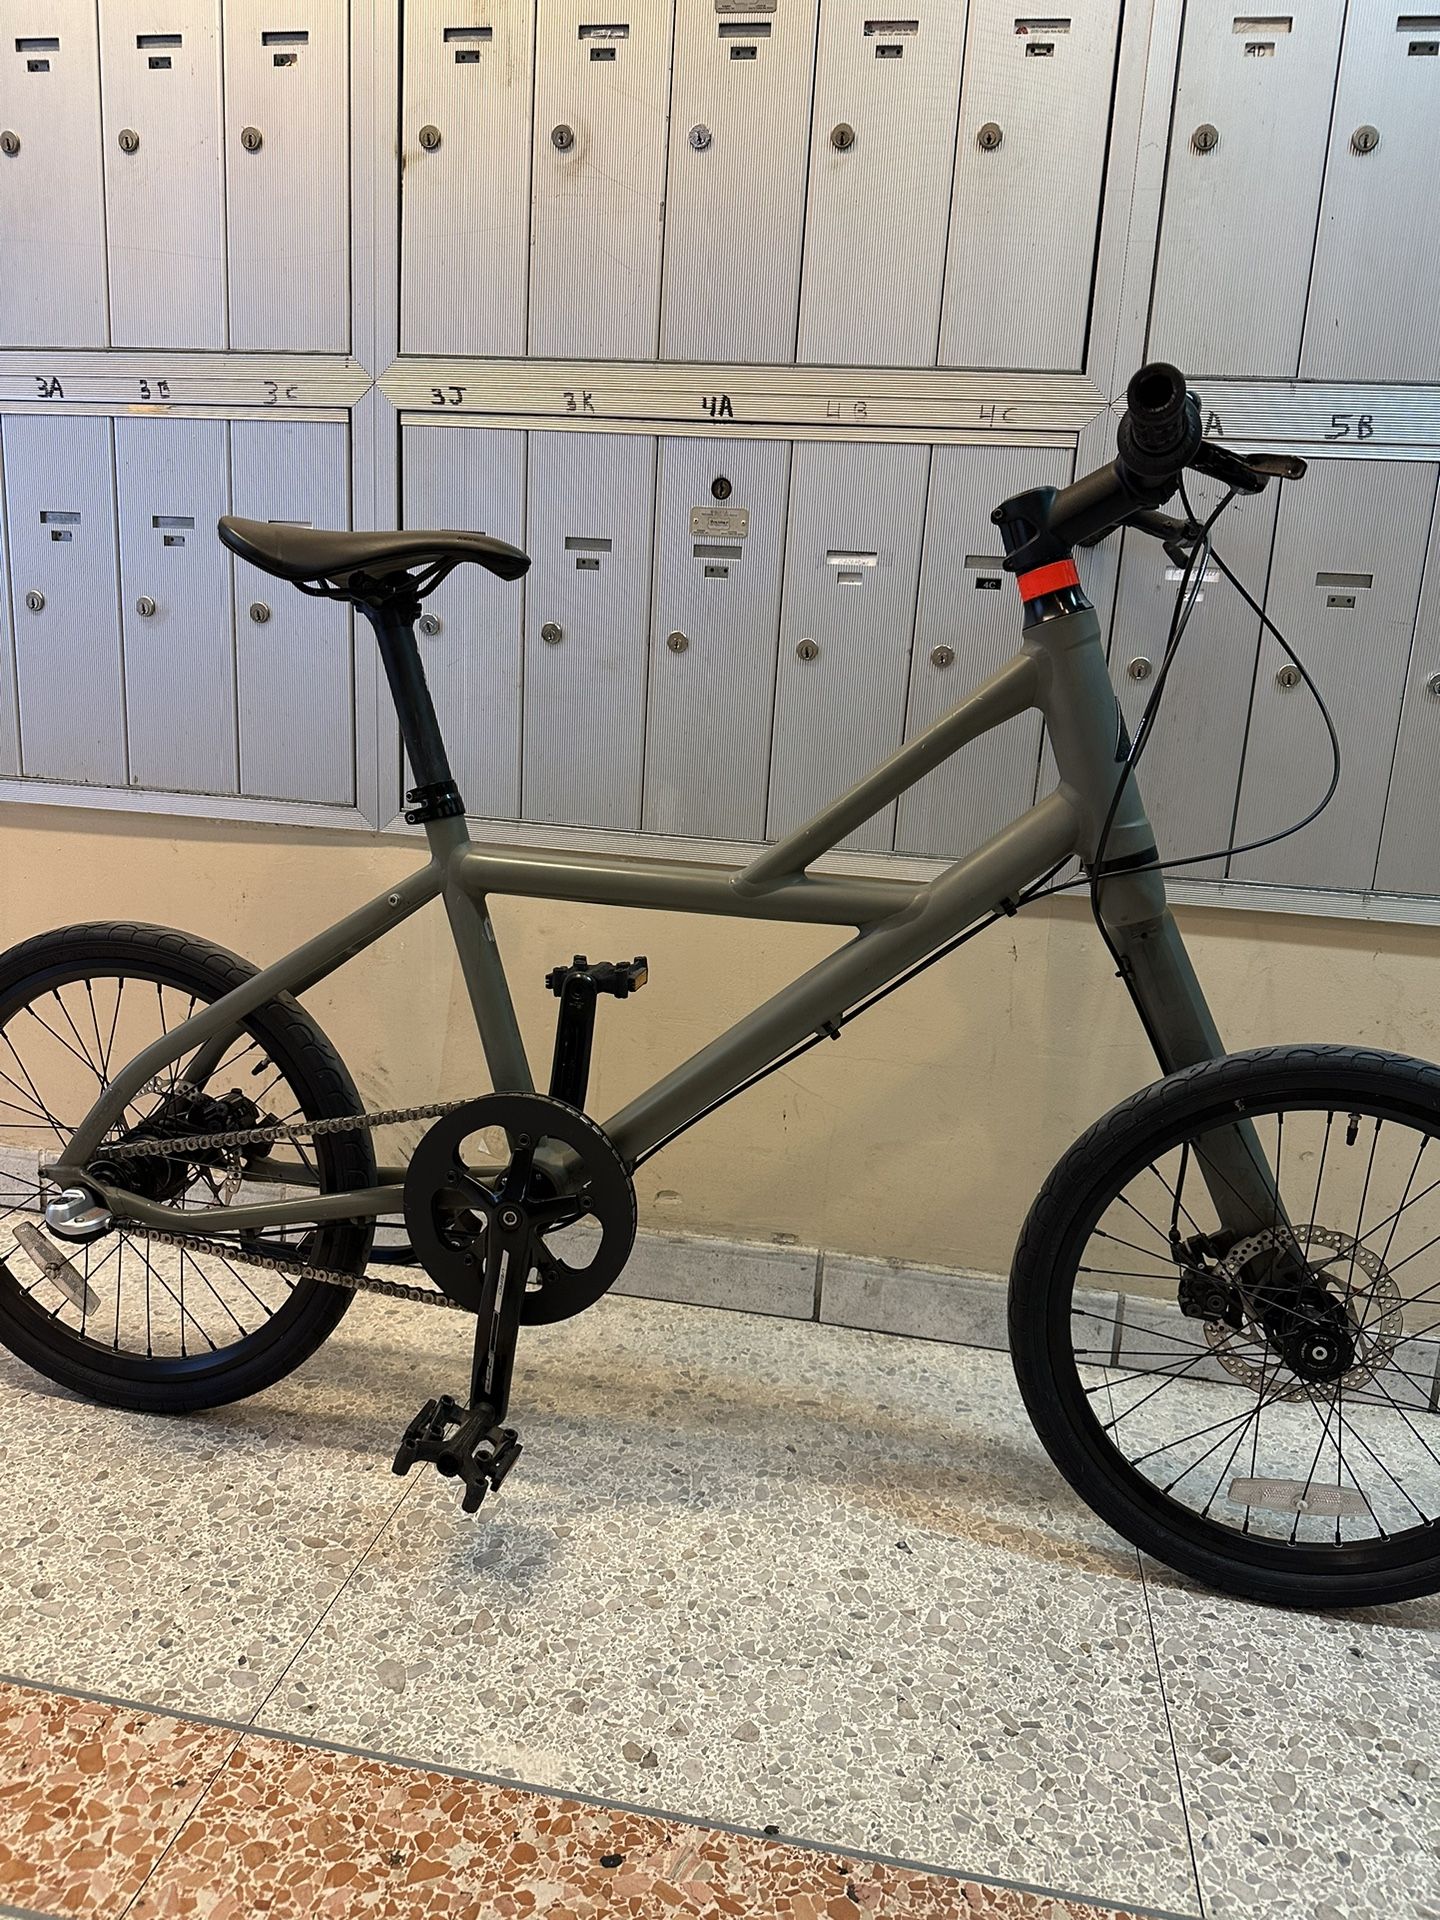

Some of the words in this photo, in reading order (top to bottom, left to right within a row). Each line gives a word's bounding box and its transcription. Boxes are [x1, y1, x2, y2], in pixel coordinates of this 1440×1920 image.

[1247, 45, 1265, 57] 4D
[35, 376, 64, 398] 3A
[431, 386, 467, 405] 3J
[563, 390, 595, 414] 3K
[701, 394, 734, 418] 4A
[826, 400, 868, 422] 4B
[979, 404, 1018, 427] 4C
[1324, 414, 1373, 440] 5B
[983, 581, 997, 589] 4C
